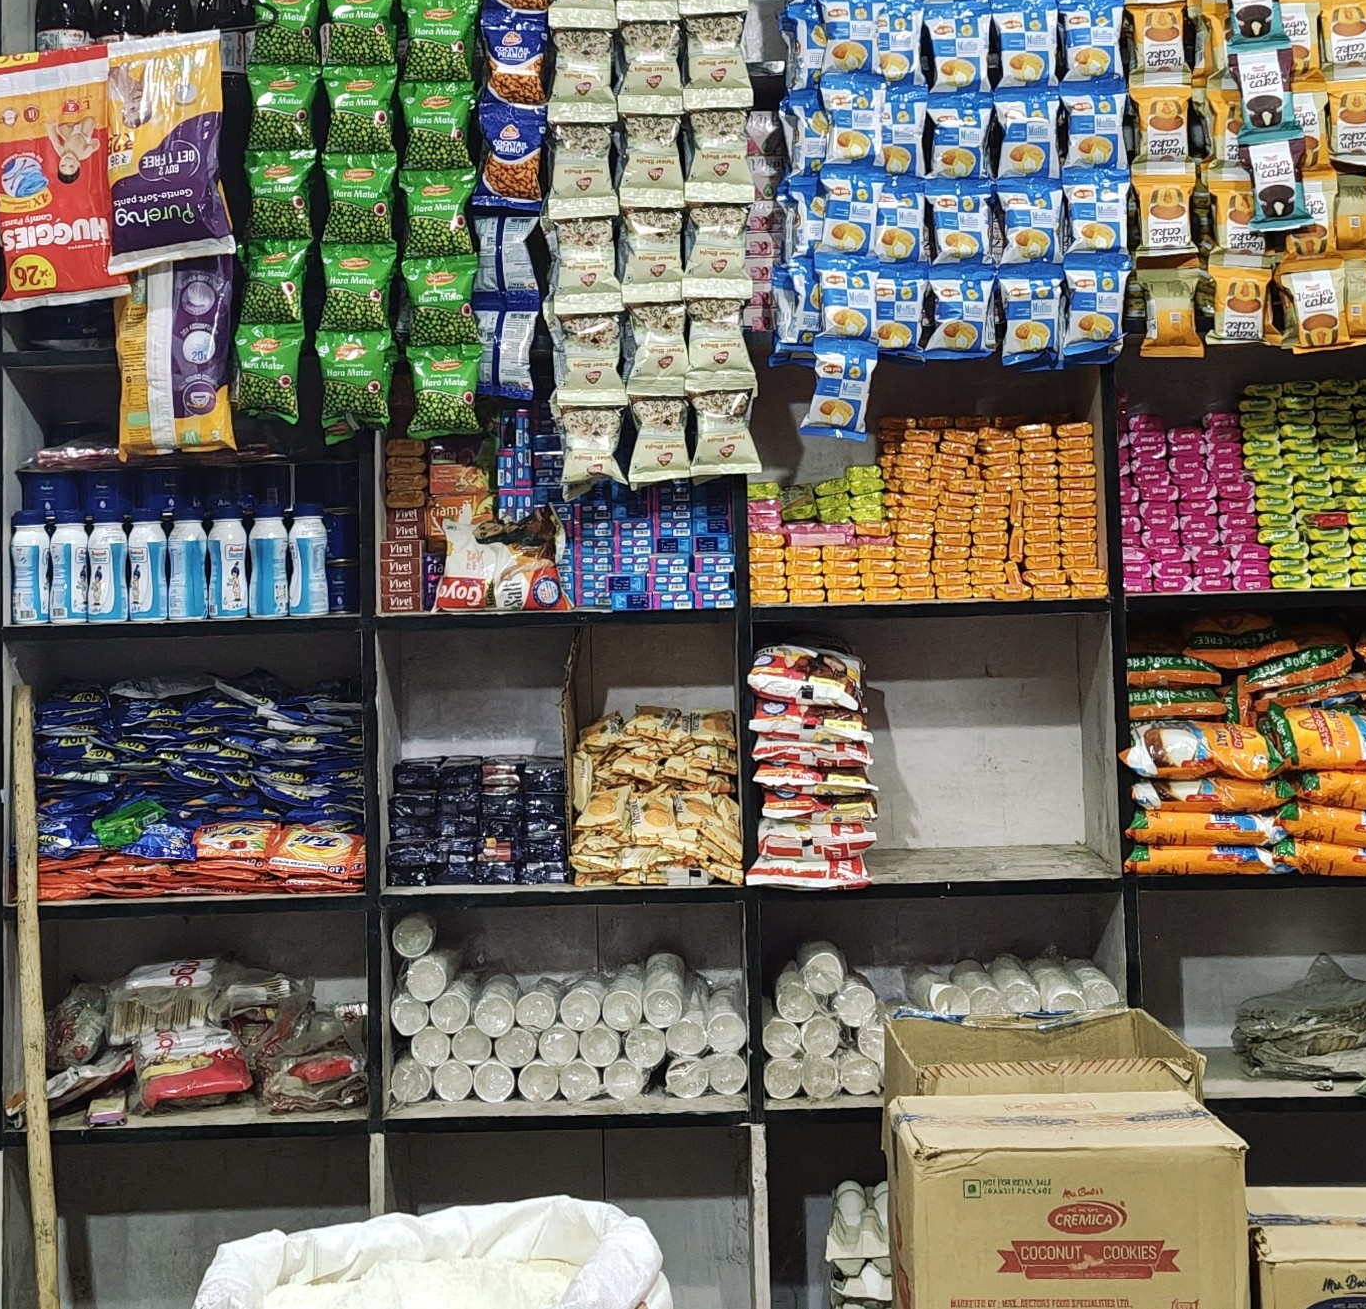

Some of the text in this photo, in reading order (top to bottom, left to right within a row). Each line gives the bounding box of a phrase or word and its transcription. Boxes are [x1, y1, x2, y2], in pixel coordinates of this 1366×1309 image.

[415, 27, 434, 36] Hara
[1250, 76, 1280, 88] cake
[142, 153, 166, 169] FREE
[165, 164, 179, 175] BUY
[114, 188, 193, 207] Gentle-Soft pants
[24, 213, 53, 225] Comfy
[115, 203, 195, 227] Purehug
[3, 216, 110, 253] HUGGIES
[330, 275, 376, 285] Hara Matar
[327, 368, 372, 378] Hara Matar
[422, 378, 469, 388] Hara Matar
[390, 544, 412, 554] Vivel
[390, 579, 412, 589] Vivel
[1055, 1213, 1113, 1227] CREMICA
[1020, 1246, 1157, 1260] COCONUT COOKIES
